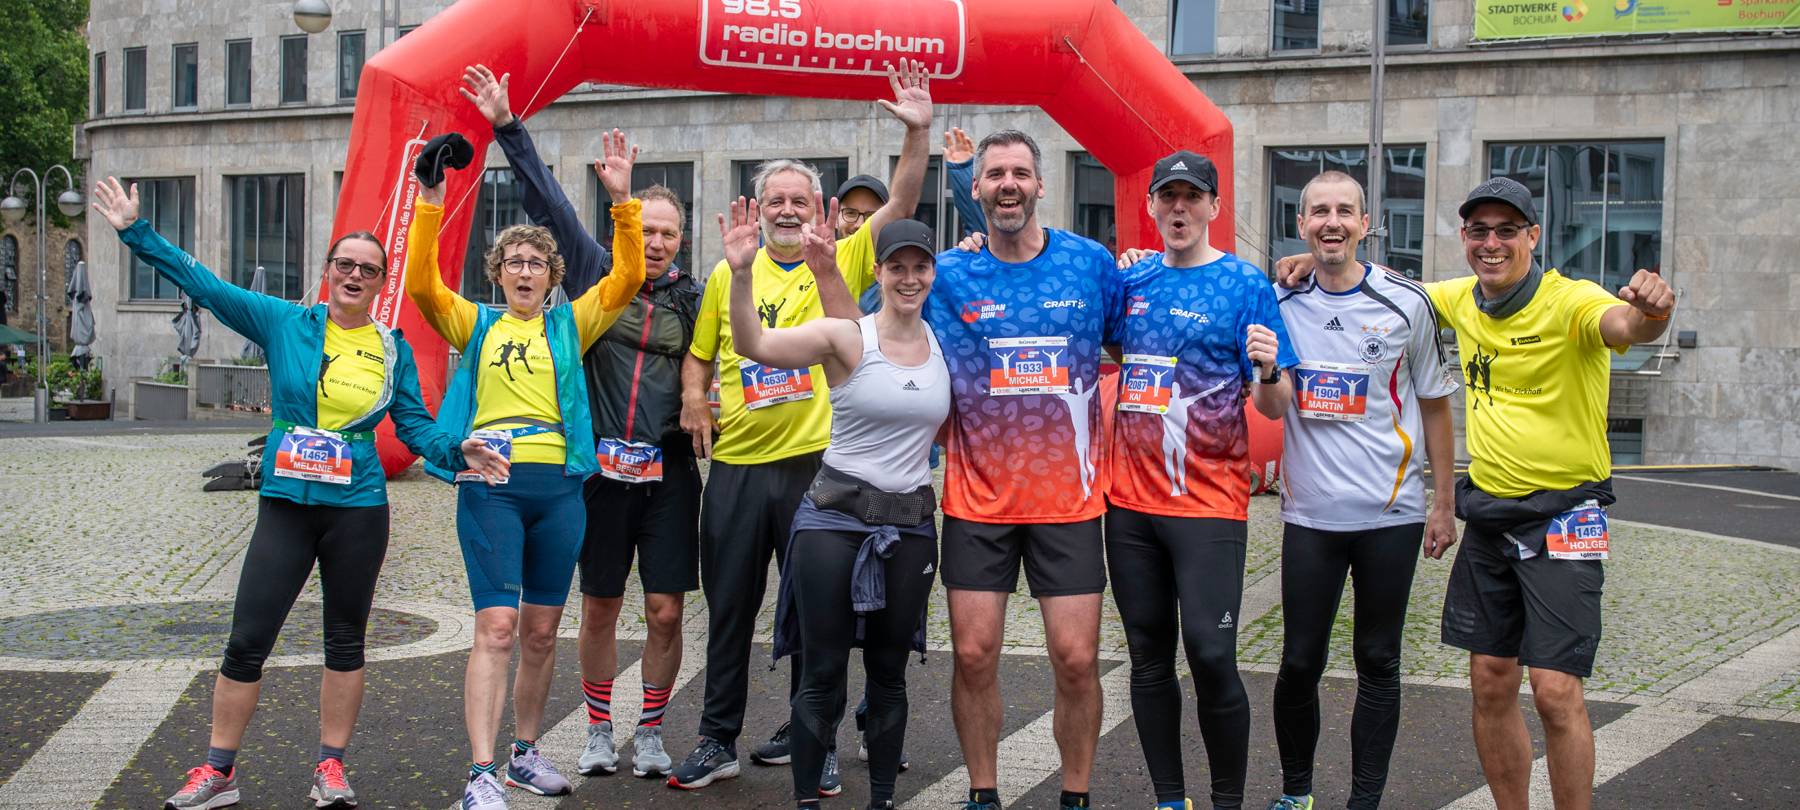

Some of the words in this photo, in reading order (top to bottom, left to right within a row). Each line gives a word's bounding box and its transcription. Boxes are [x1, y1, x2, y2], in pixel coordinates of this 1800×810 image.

[723, 0, 802, 19] 98.5
[1488, 3, 1558, 15] STADTWERKE
[1739, 10, 1785, 20] Bochum
[1513, 15, 1557, 26] BOCHUM
[723, 23, 808, 47] radio
[814, 26, 945, 54] bochum
[403, 184, 416, 211] beste
[400, 211, 411, 226] die
[394, 226, 408, 254] 100%
[388, 276, 397, 295] von
[981, 304, 1006, 312] URBAN
[1043, 300, 1078, 309] CRAFT
[1169, 308, 1201, 321] CRAFT
[1016, 363, 1042, 373] 1933
[763, 373, 787, 386] 4630
[1008, 375, 1051, 385] MICHAEL
[759, 384, 797, 398] MICHAEL
[1129, 393, 1141, 401] KAI
[1315, 387, 1340, 400] 1904
[1308, 400, 1344, 411] MARTIN
[303, 449, 328, 461] 1462
[293, 462, 334, 473] MELANIE
[615, 463, 642, 475] BERND
[1576, 526, 1603, 538] 1463
[1569, 540, 1608, 550] HOLGER
